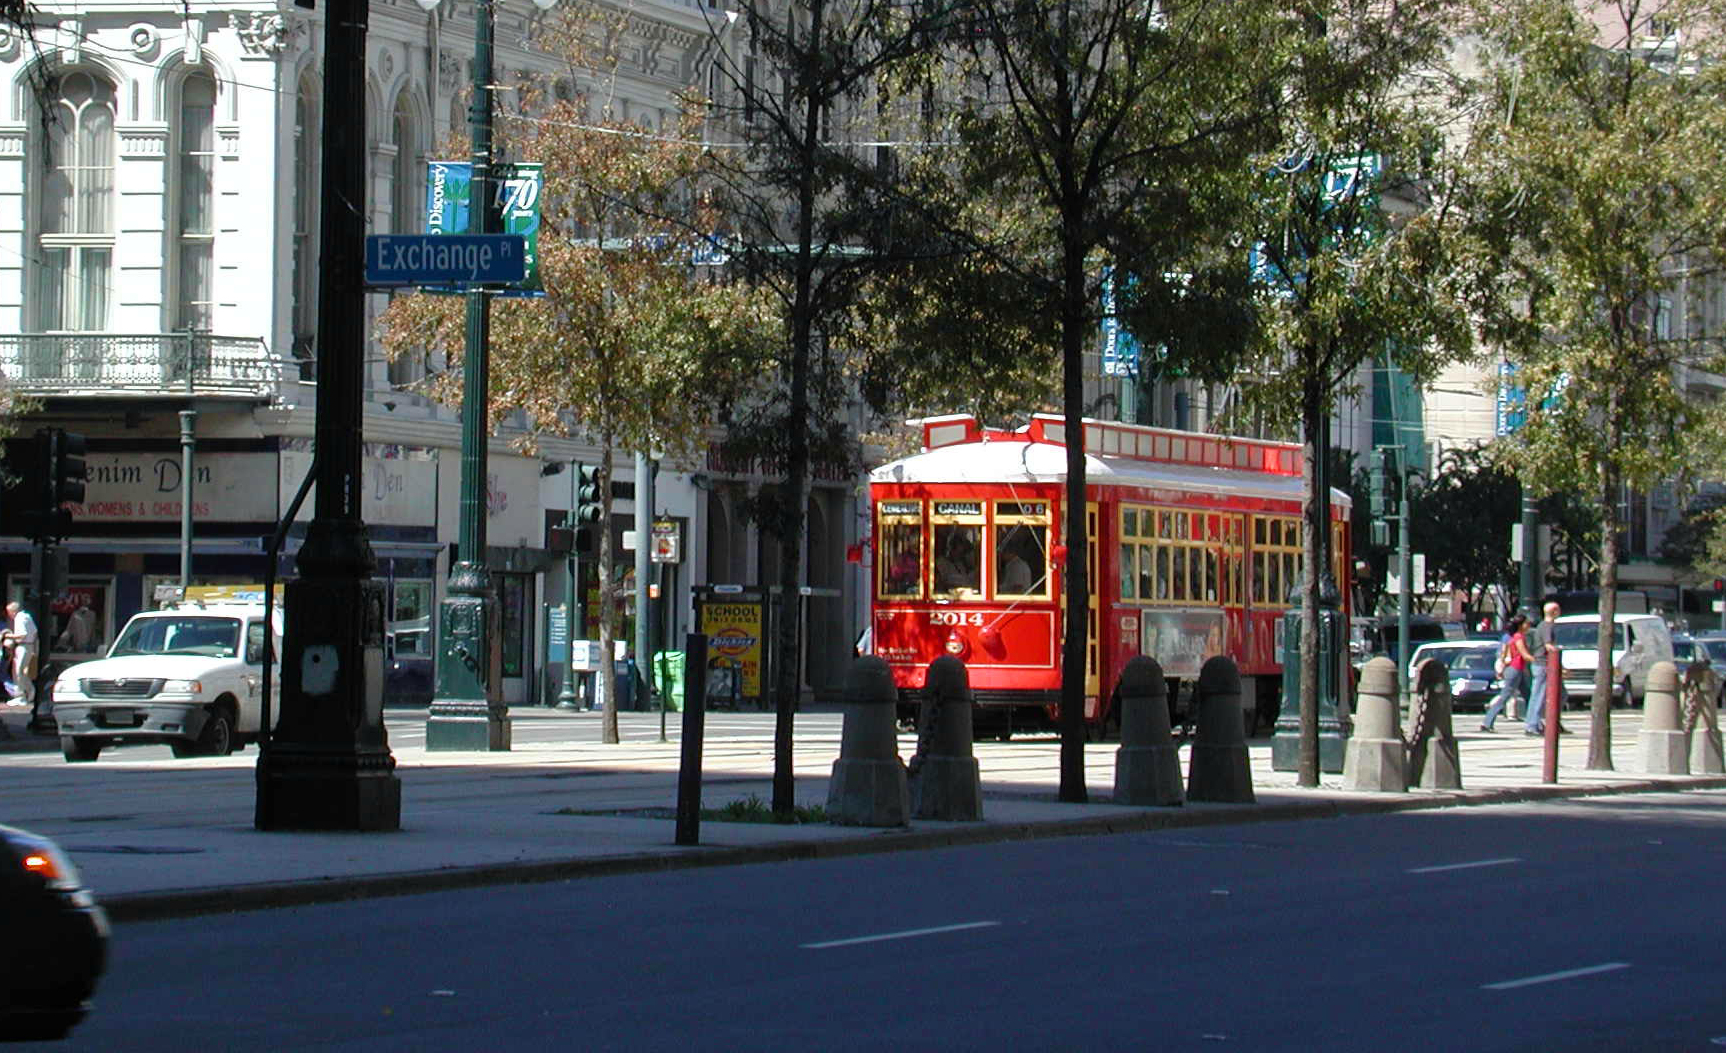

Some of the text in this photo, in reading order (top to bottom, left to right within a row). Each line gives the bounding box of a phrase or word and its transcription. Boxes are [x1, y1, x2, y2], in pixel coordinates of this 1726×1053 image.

[429, 164, 448, 226] Discovery
[377, 238, 492, 279] Exchange
[500, 240, 512, 258] Pl
[85, 458, 212, 492] enim Dn
[88, 502, 132, 516] WOMENS
[937, 503, 981, 515] CANAL
[706, 605, 758, 616] SCHOOL
[929, 612, 984, 626] 2014
